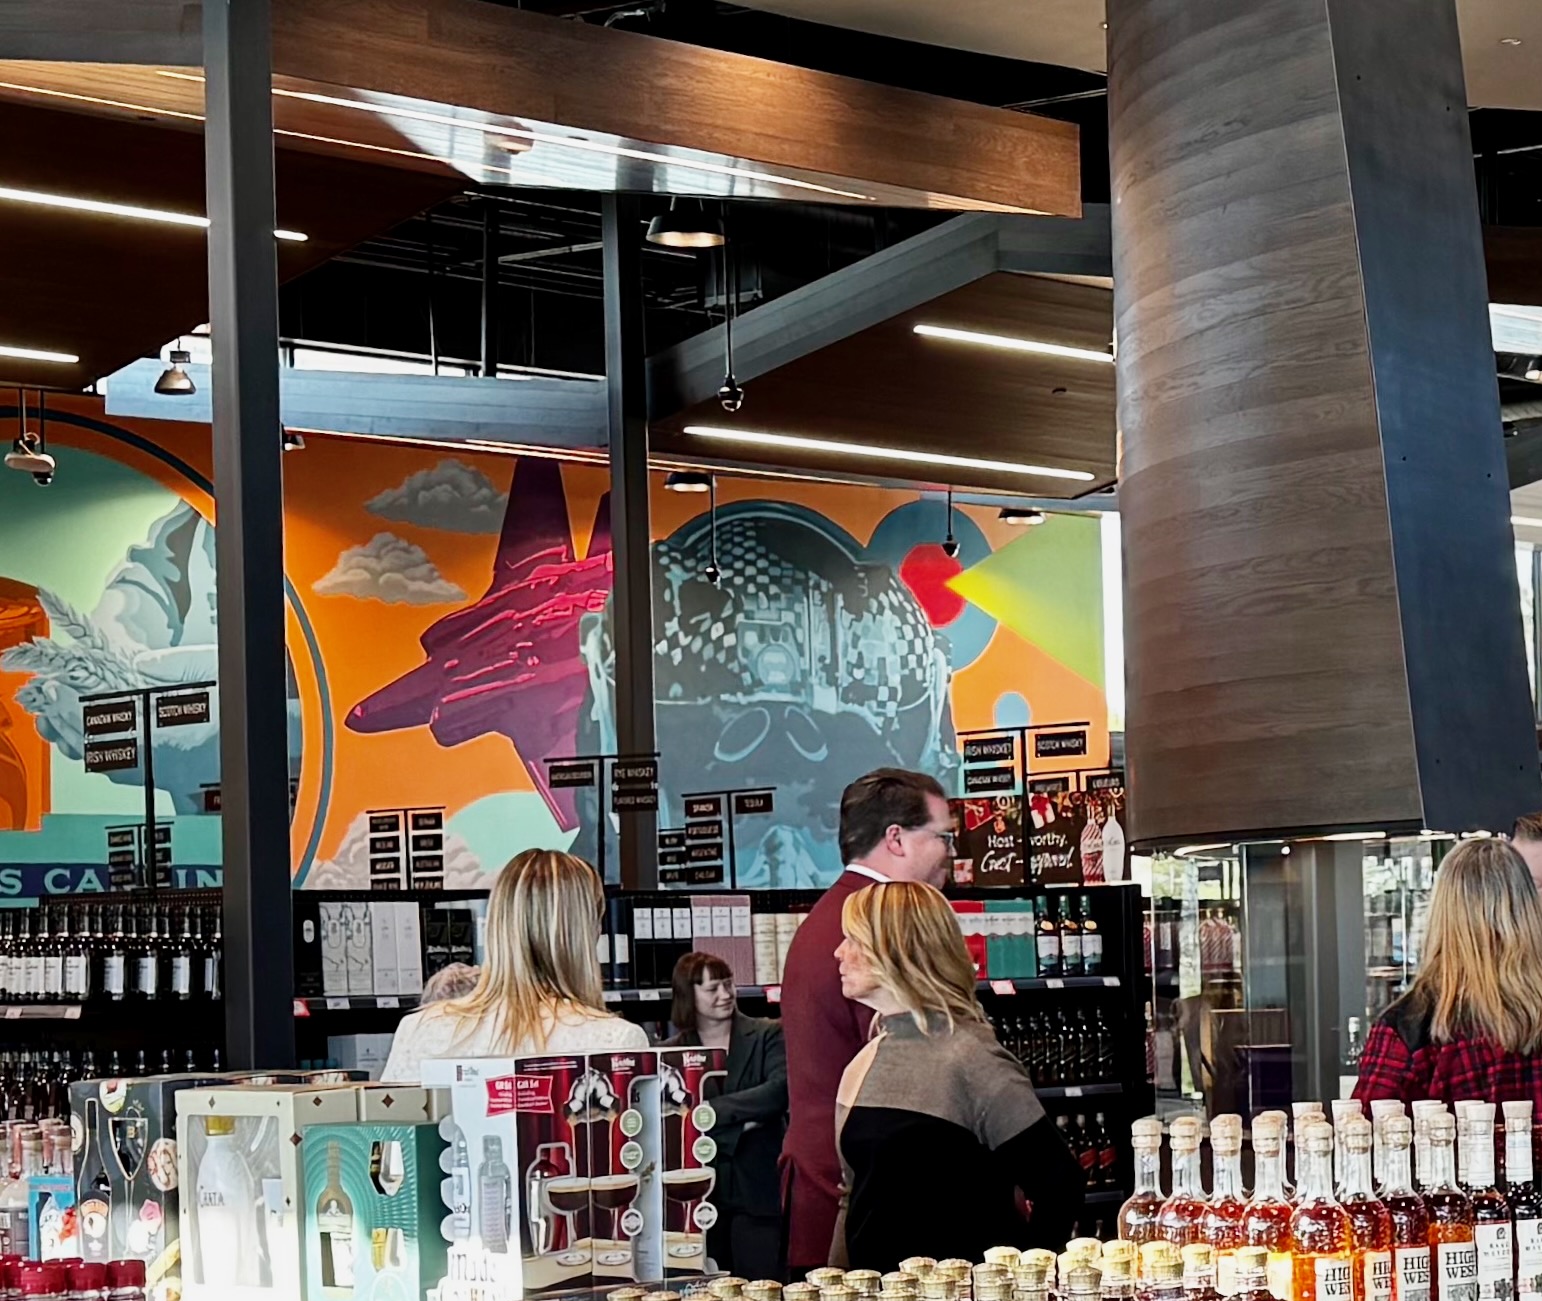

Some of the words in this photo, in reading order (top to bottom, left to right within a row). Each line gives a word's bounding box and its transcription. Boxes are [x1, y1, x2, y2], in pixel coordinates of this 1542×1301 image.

[158, 705, 182, 718] SCOTCH
[86, 751, 104, 764] IRISH
[105, 747, 136, 762] WHISKEY
[1373, 1261, 1391, 1276] HI
[1403, 1255, 1430, 1271] HIG
[1325, 1266, 1350, 1281] HIG
[1404, 1270, 1430, 1284] WES
[1373, 1277, 1390, 1289] WE
